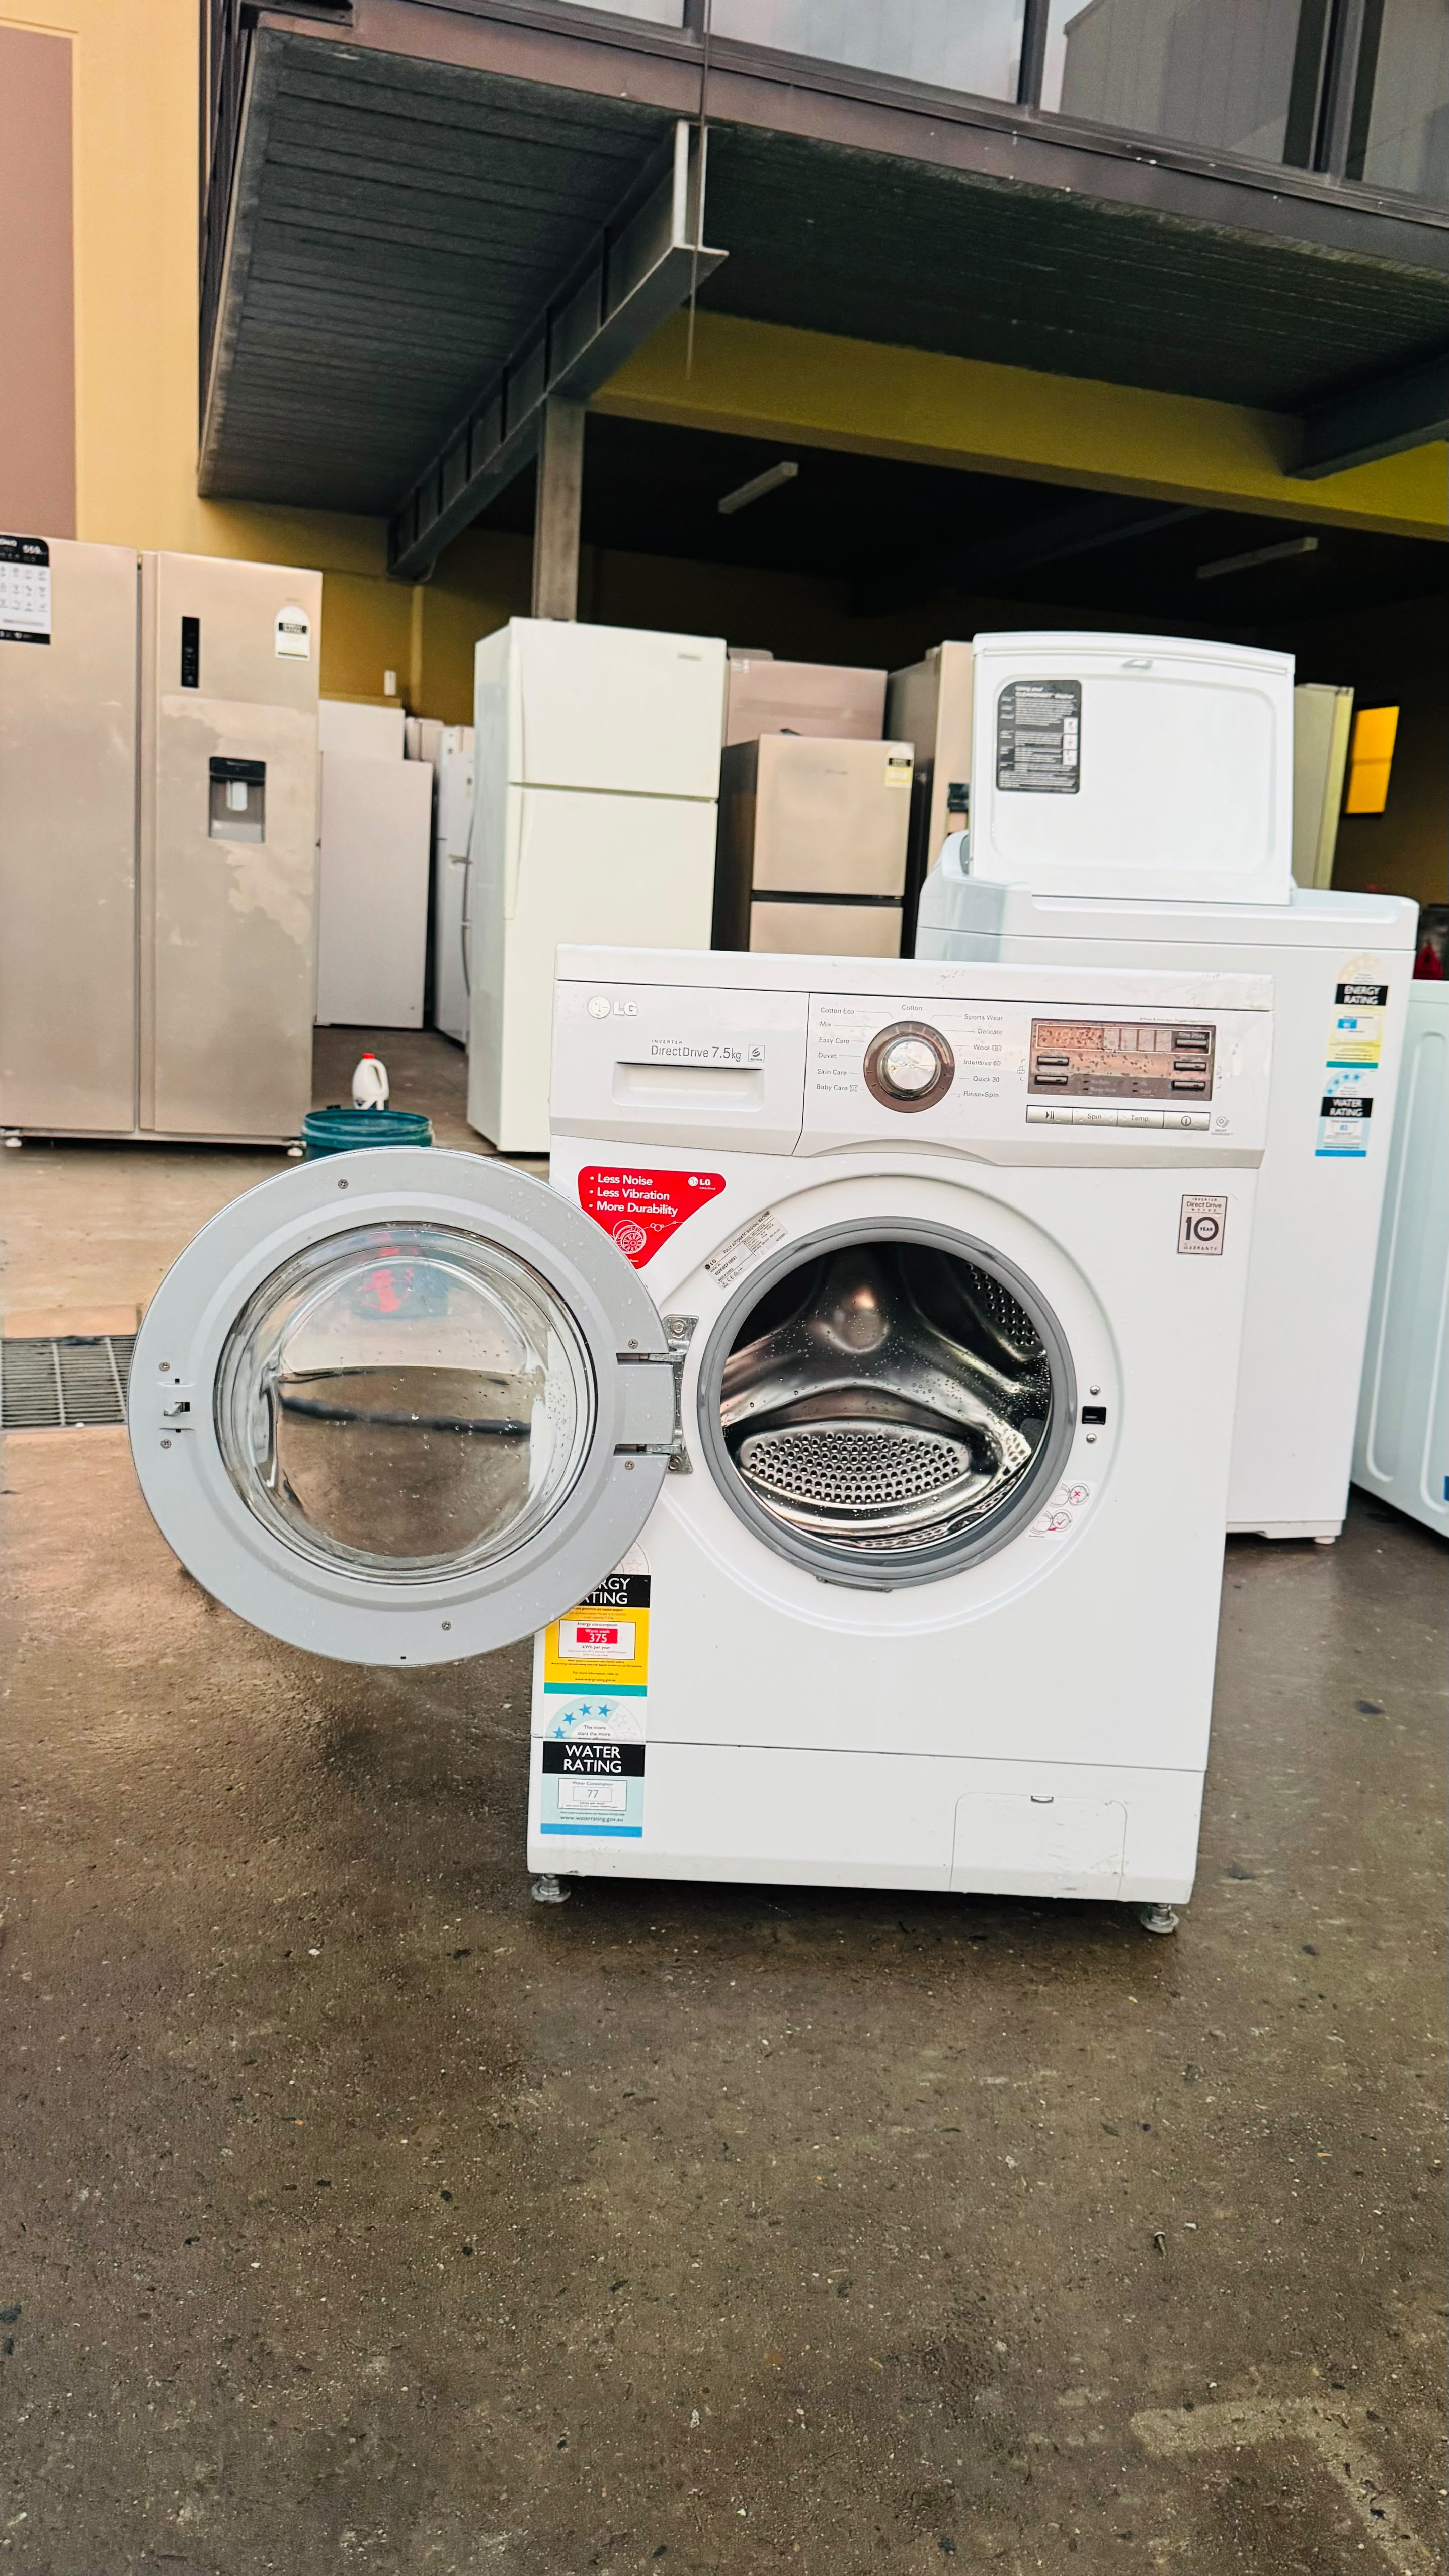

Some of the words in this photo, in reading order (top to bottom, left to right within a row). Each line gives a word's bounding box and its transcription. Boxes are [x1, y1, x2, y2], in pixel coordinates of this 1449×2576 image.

[613, 1001, 638, 1016] LG
[598, 1173, 620, 1184] Less
[622, 1175, 653, 1186] Noise
[597, 1187, 620, 1198] Less
[622, 1188, 670, 1201] Vibration
[596, 1201, 625, 1213] More
[627, 1203, 678, 1217] Durability
[1185, 1217, 1219, 1241] 10
[589, 1633, 607, 1643] 375
[565, 1745, 621, 1759] WATER
[563, 1759, 622, 1773] RATING
[587, 1789, 599, 1798] 77
